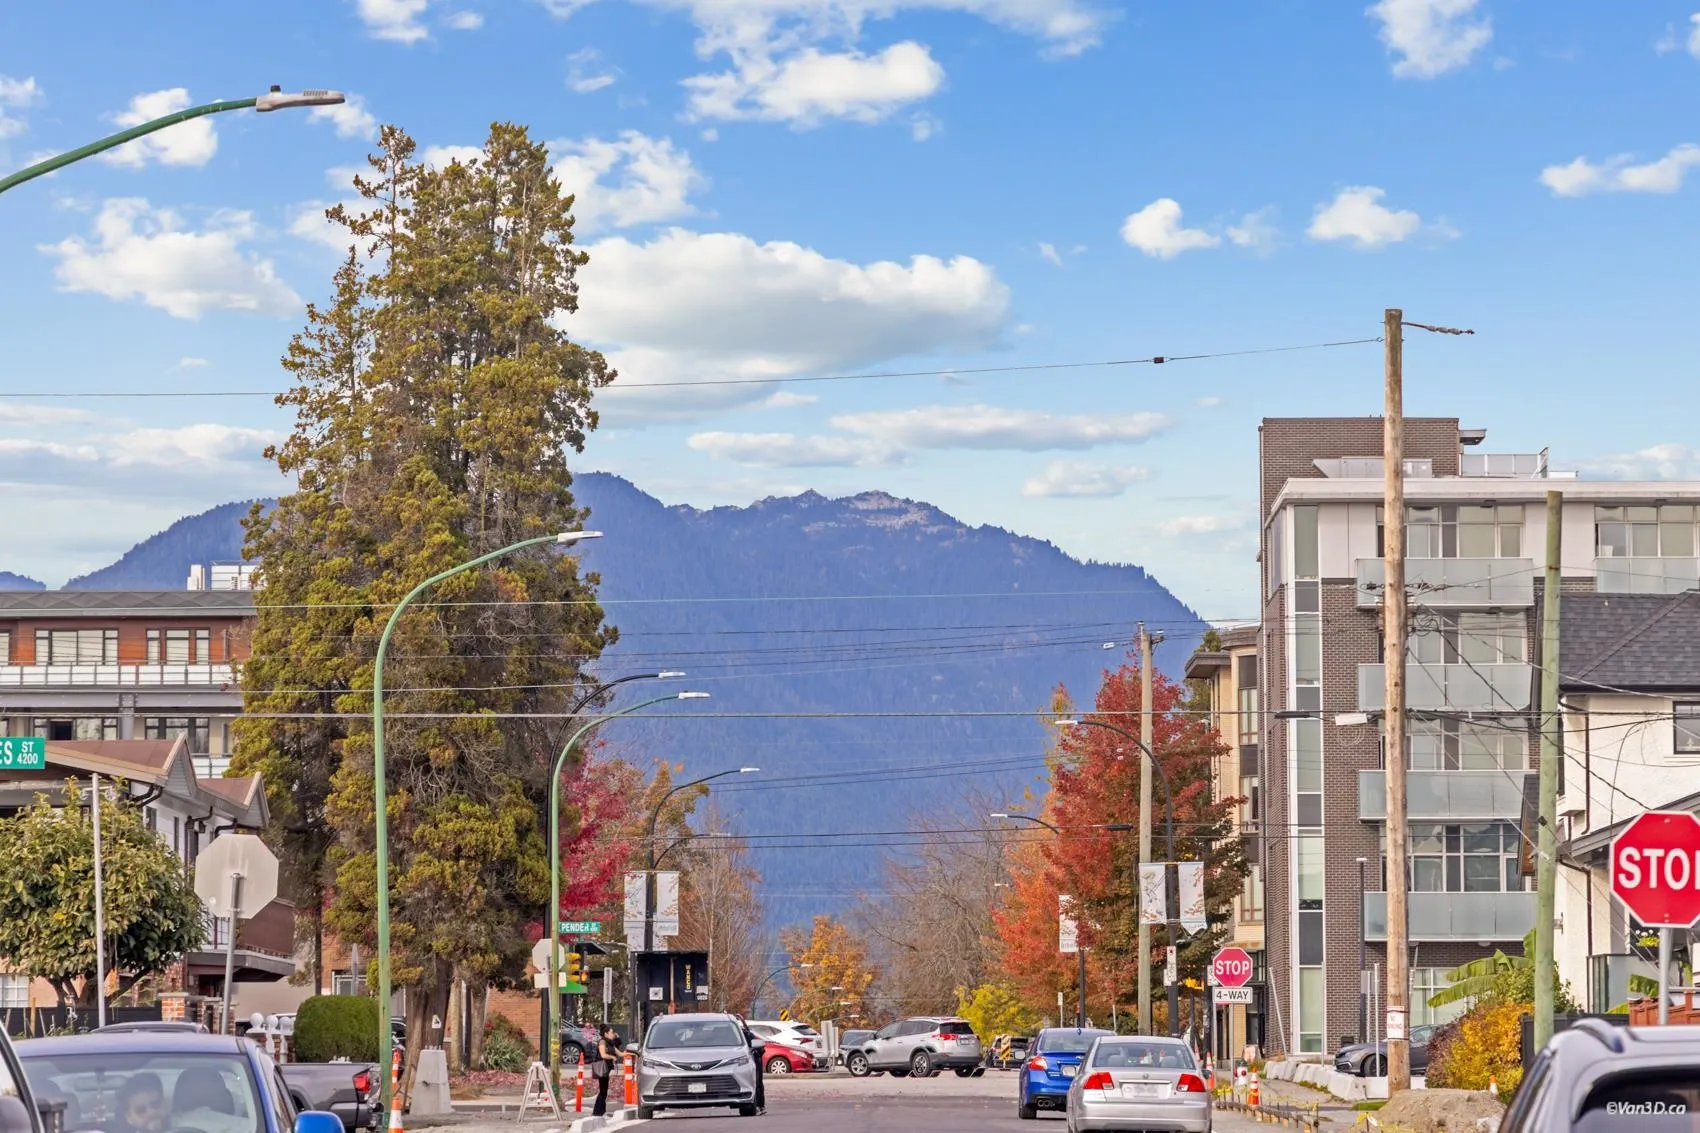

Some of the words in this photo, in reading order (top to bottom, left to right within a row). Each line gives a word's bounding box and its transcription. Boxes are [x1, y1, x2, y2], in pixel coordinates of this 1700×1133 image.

[21, 741, 34, 752] ST
[17, 753, 38, 764] 4200
[1618, 846, 1700, 890] STO
[561, 923, 590, 932] PENDER
[1216, 960, 1249, 975] STOP
[1216, 991, 1249, 999] 4-WAY
